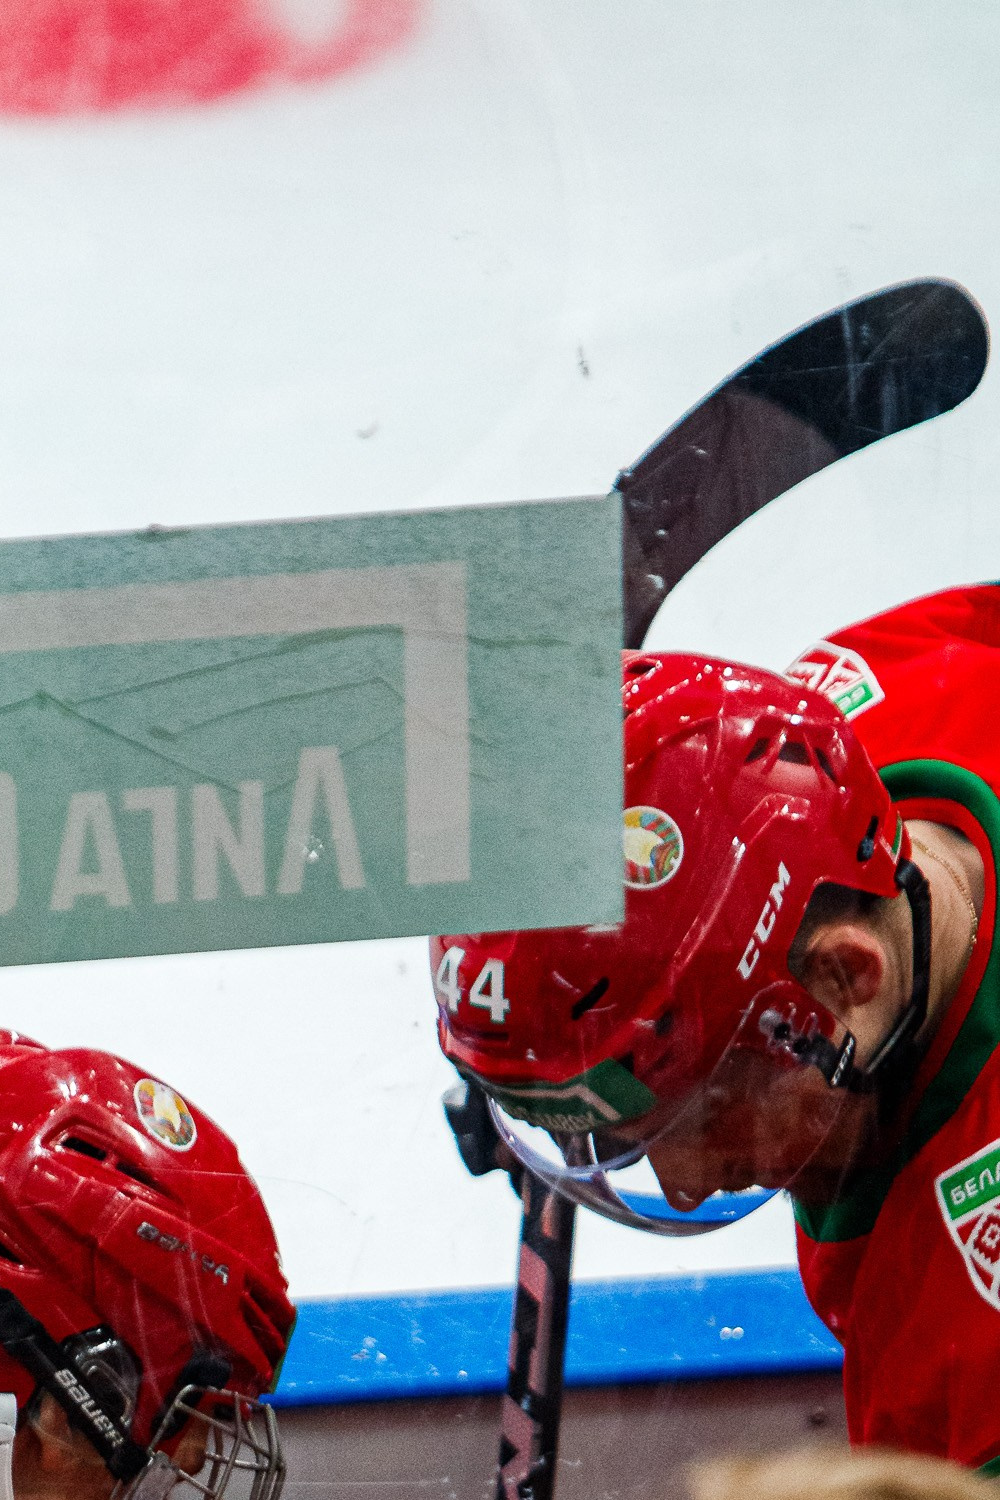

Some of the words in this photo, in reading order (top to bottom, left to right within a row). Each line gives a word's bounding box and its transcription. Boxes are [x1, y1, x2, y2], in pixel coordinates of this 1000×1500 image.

[736, 860, 791, 981] CCM
[435, 945, 512, 1024] 44
[54, 1368, 124, 1448] BAUER
